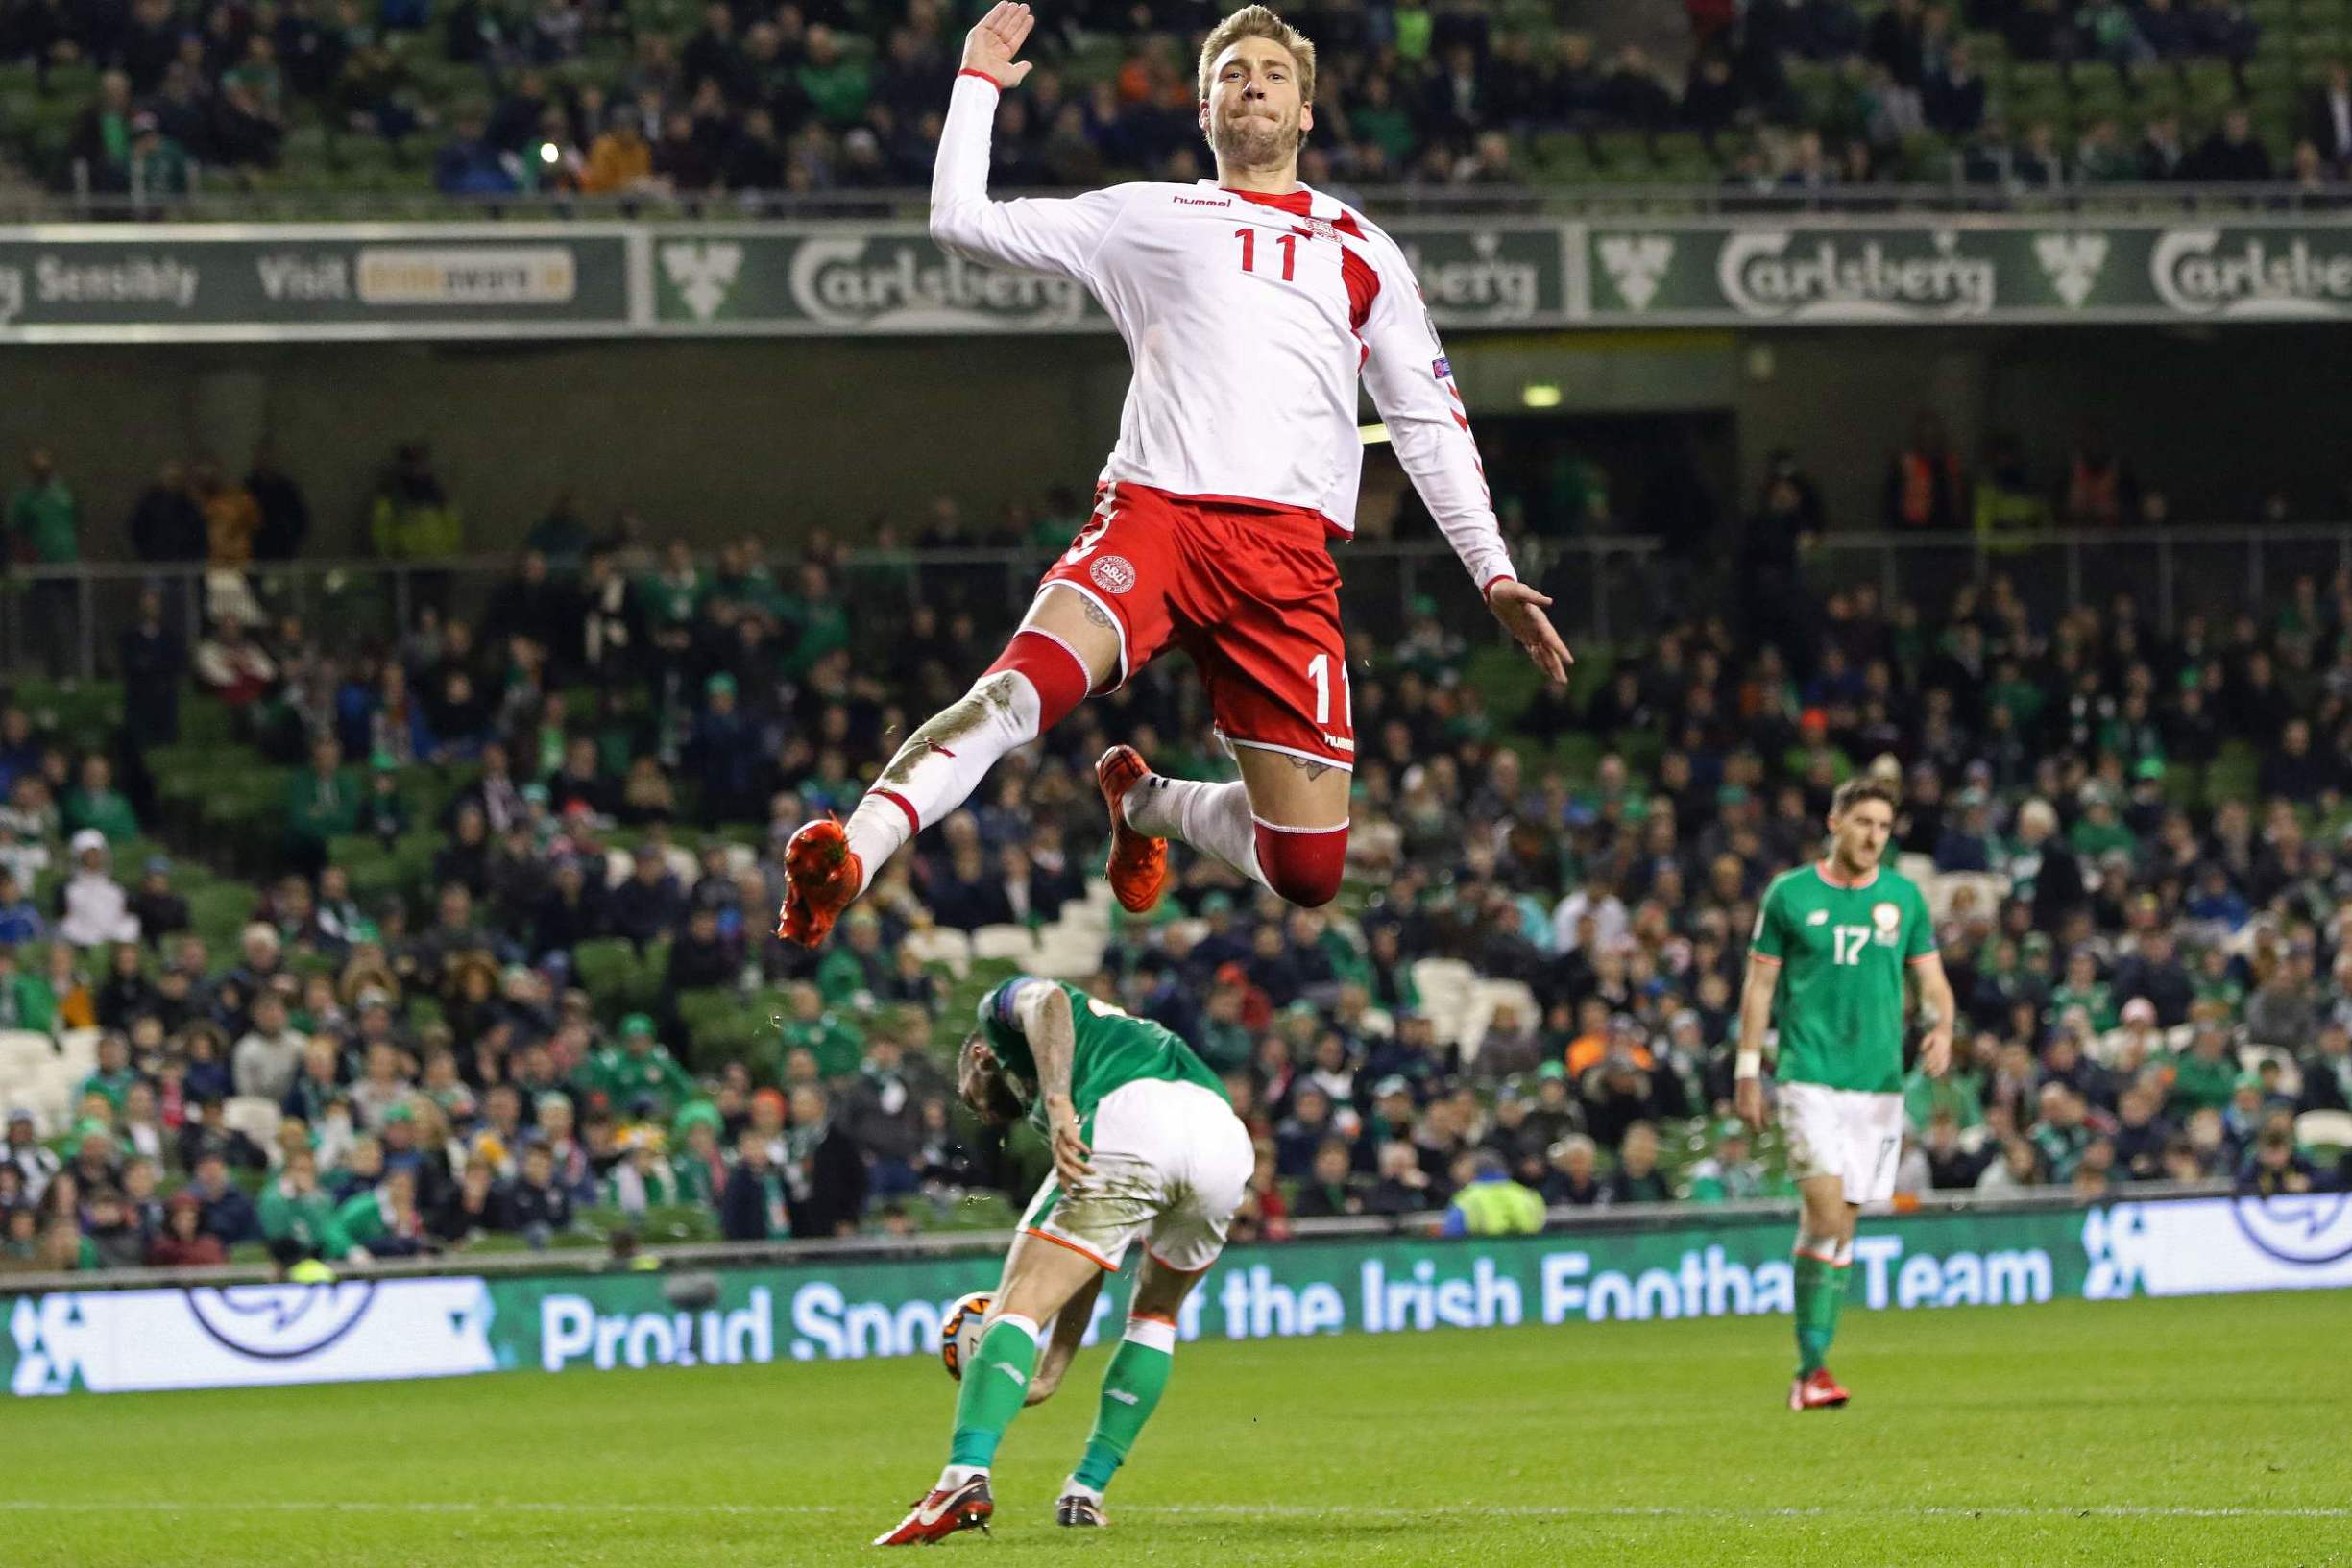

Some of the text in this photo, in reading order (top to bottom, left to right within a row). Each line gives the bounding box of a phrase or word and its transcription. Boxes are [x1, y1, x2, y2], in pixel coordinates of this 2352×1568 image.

[1174, 195, 1231, 208] hummel
[1235, 228, 1297, 281] 11
[1716, 230, 1996, 320] Carlsberg
[2149, 229, 2352, 317] Carlsbe
[1833, 925, 1871, 965] 17
[1219, 1265, 1344, 1340] the
[1360, 1257, 1522, 1333] Irish
[1540, 1245, 1794, 1325] Footba
[1853, 1234, 2053, 1310] Team
